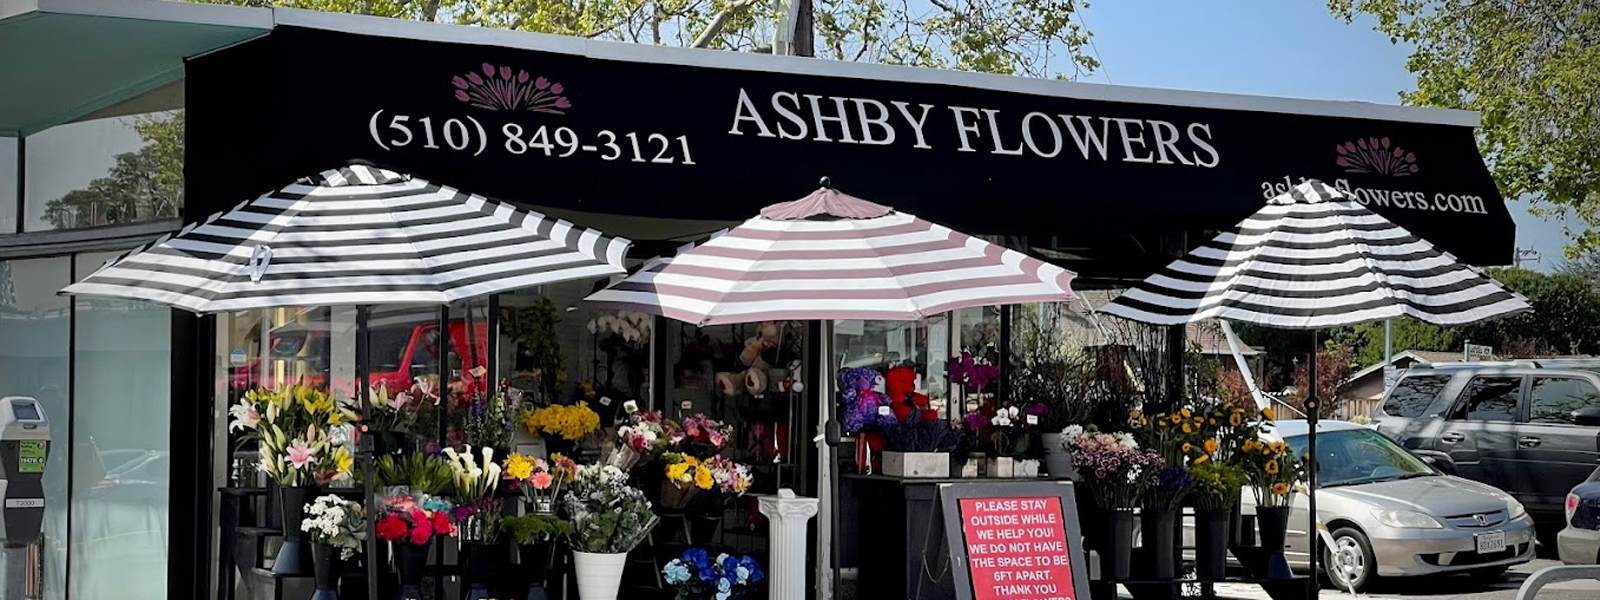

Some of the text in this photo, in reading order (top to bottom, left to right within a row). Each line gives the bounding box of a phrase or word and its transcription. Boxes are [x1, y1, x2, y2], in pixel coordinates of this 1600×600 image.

[728, 88, 1219, 167] ASHBY FLOWERS
[370, 110, 695, 164] (510) 849-3121
[976, 500, 1047, 511] PLEASE STAY
[971, 513, 1056, 526] OUTSIDE WHILE
[977, 528, 1054, 540] WE HELP YOU!
[969, 541, 1063, 554] WE DO NOT HAVE
[972, 555, 1068, 568] THE SPACE TO BE
[994, 570, 1052, 581] 6FT APART.
[993, 584, 1057, 596] THANK YOU
